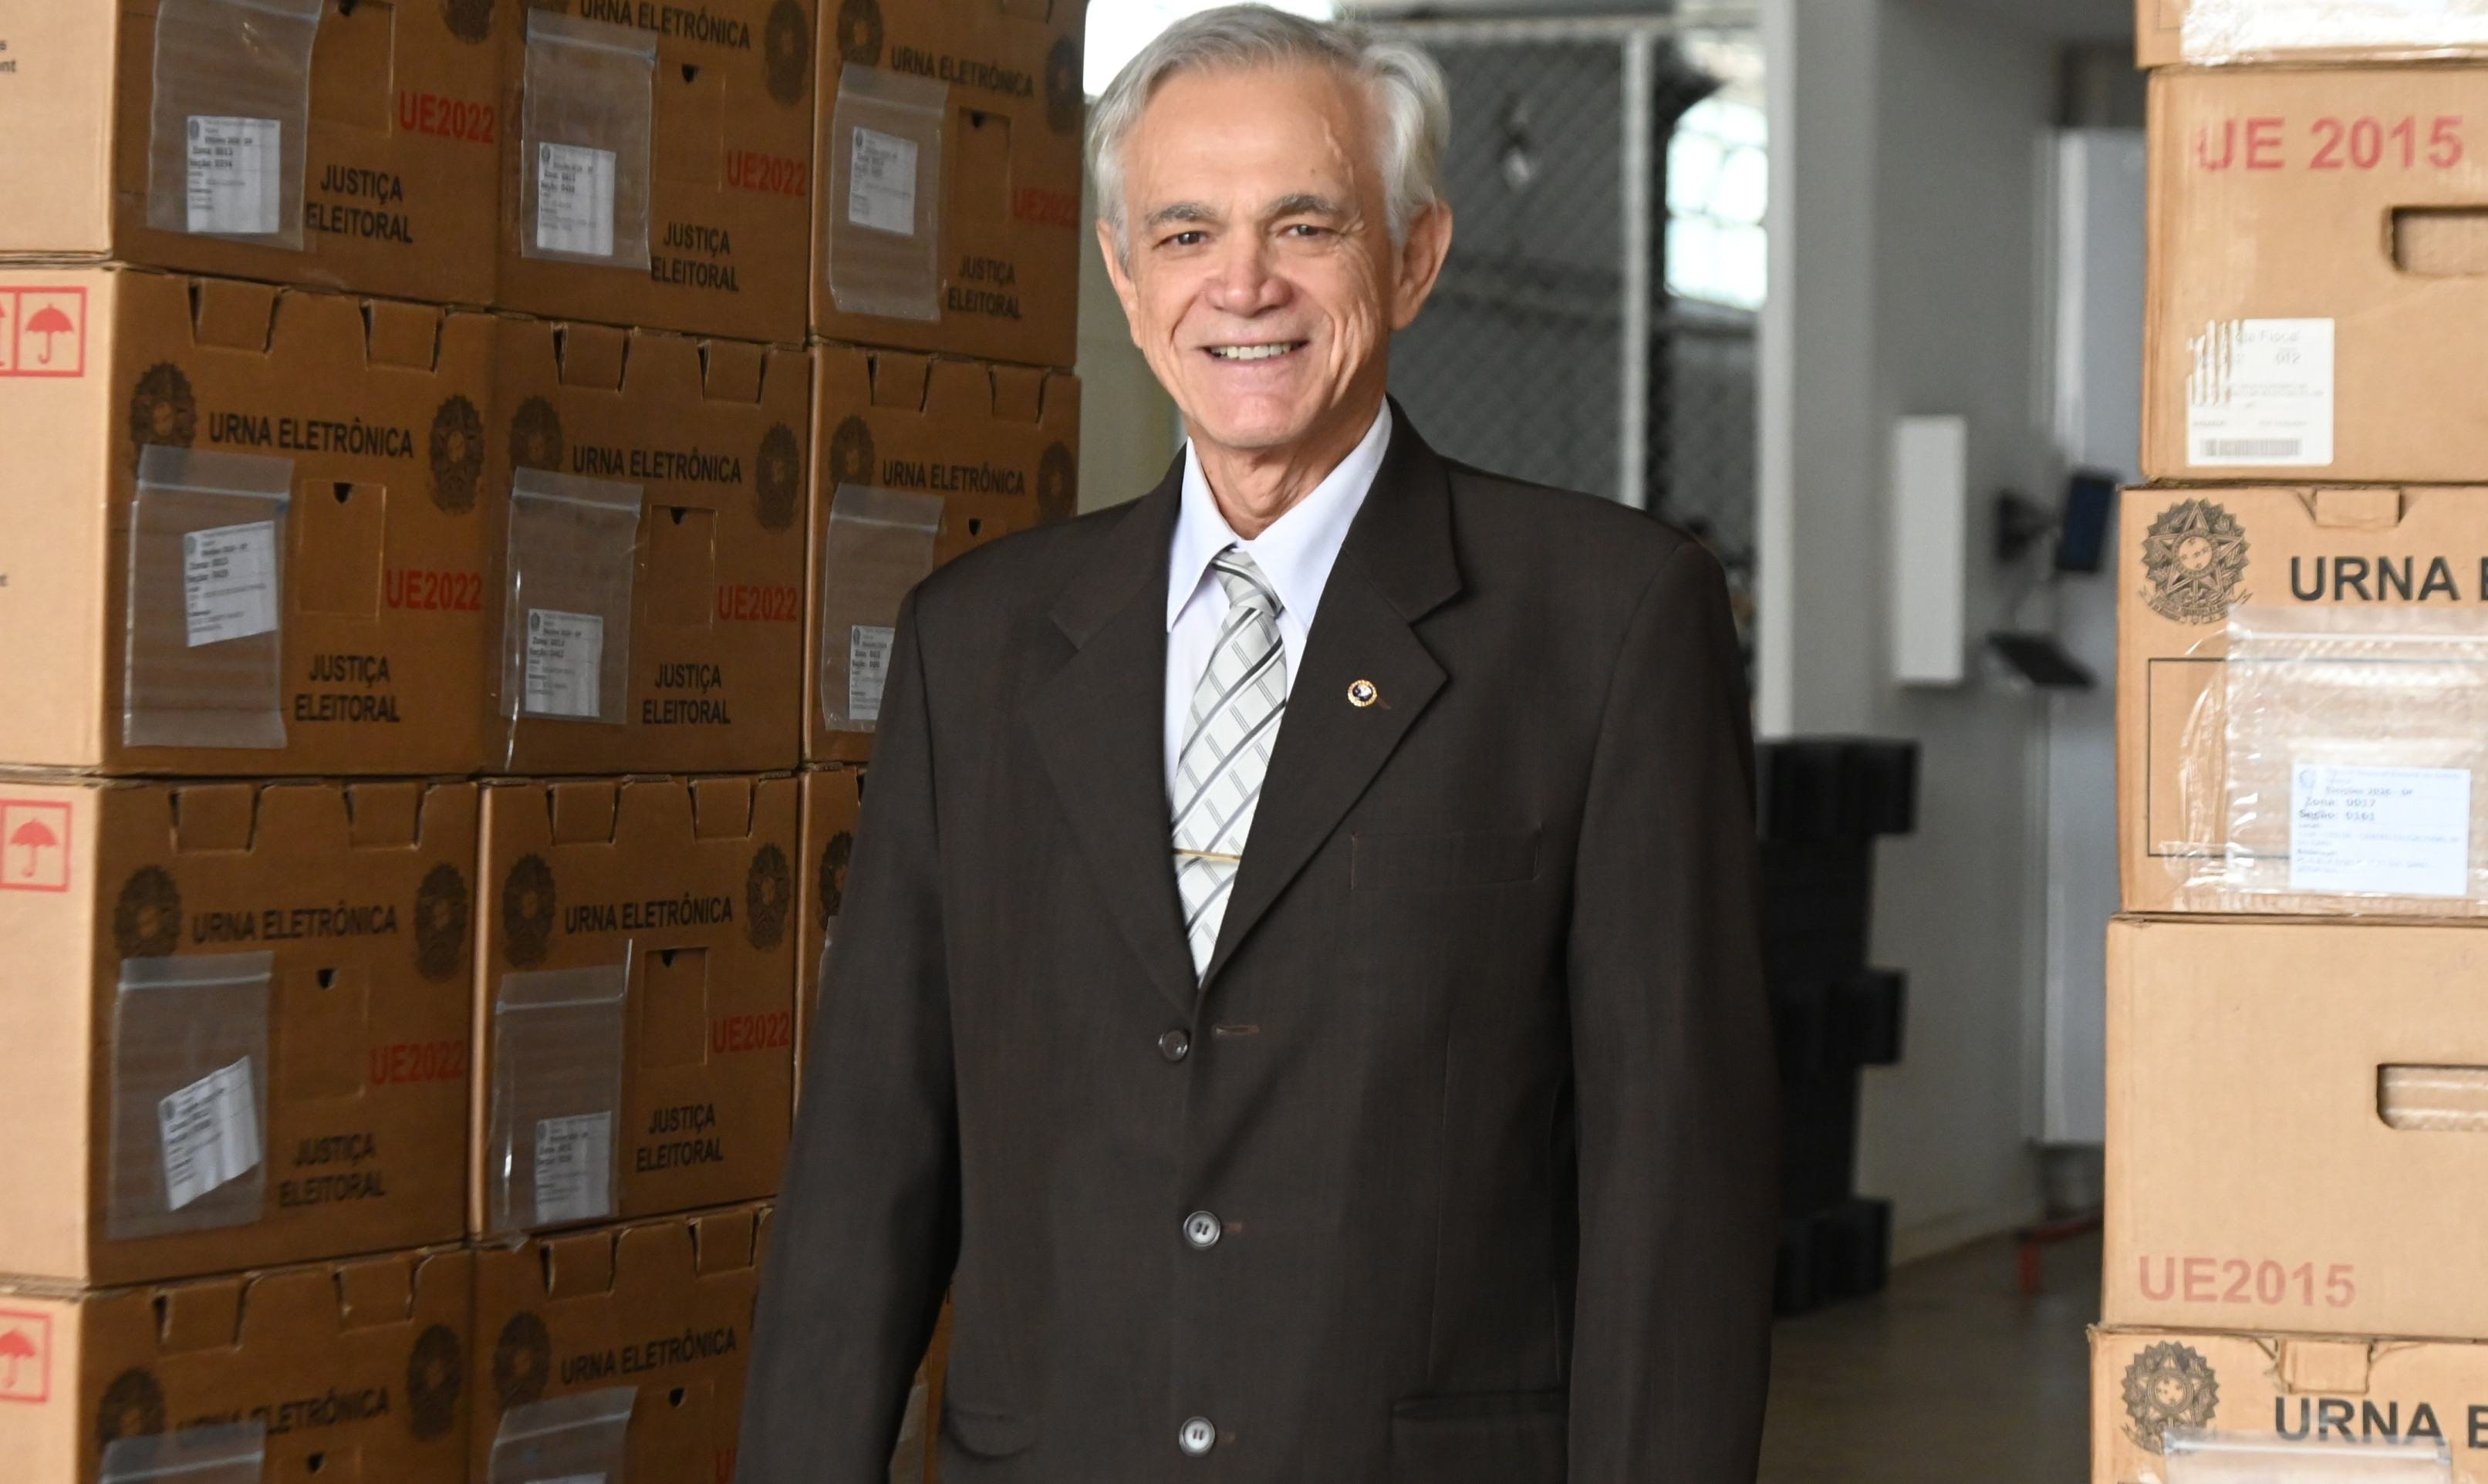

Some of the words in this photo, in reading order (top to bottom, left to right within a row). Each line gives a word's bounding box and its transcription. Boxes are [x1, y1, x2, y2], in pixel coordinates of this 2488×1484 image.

[580, 0, 632, 26] URNA
[891, 45, 935, 77] URNA
[398, 89, 495, 144] UE2022
[2197, 116, 2287, 171] UE
[2309, 114, 2465, 171] 2015
[320, 164, 403, 203] JUSTIÇA
[727, 150, 807, 197] UE2022
[306, 201, 414, 245] ELEITORAL
[663, 222, 731, 255] JUSTIÇA
[650, 257, 740, 292] ELEITORAL
[959, 255, 1017, 288] JUSTIÇA
[947, 288, 1023, 319] ELEITORAL
[209, 412, 273, 447] URNA
[279, 417, 414, 459] ELETRÔNICA
[572, 444, 625, 477] URNA
[630, 447, 743, 484] ELETRÔNICA
[883, 459, 927, 488] URNA
[930, 464, 1026, 496] ELETRÔNICA
[386, 568, 483, 612] UE2022
[2290, 555, 2462, 602] URNA
[717, 585, 798, 623] UE2022
[309, 654, 391, 689] JUSTIÇA
[653, 663, 722, 694] JUSTIÇA
[293, 693, 401, 723] ELEITORAL
[641, 699, 731, 725] ELEITORAL
[192, 912, 258, 945] URNA
[564, 903, 616, 934] URNA
[621, 892, 734, 930] ELETRÔNICA
[712, 1010, 790, 1054] UE2022
[369, 1040, 464, 1085] UE2022
[648, 1103, 715, 1134] JUSTIÇA
[295, 1132, 376, 1168] JUSTIÇA
[635, 1138, 724, 1172] ELEITORAL
[278, 1172, 387, 1209] ELEITORAL
[2139, 1255, 2356, 1309] UE2015
[559, 1350, 616, 1385] URNA
[621, 1327, 738, 1375] ELETRÔNICA
[2274, 1395, 2446, 1446] URNA
